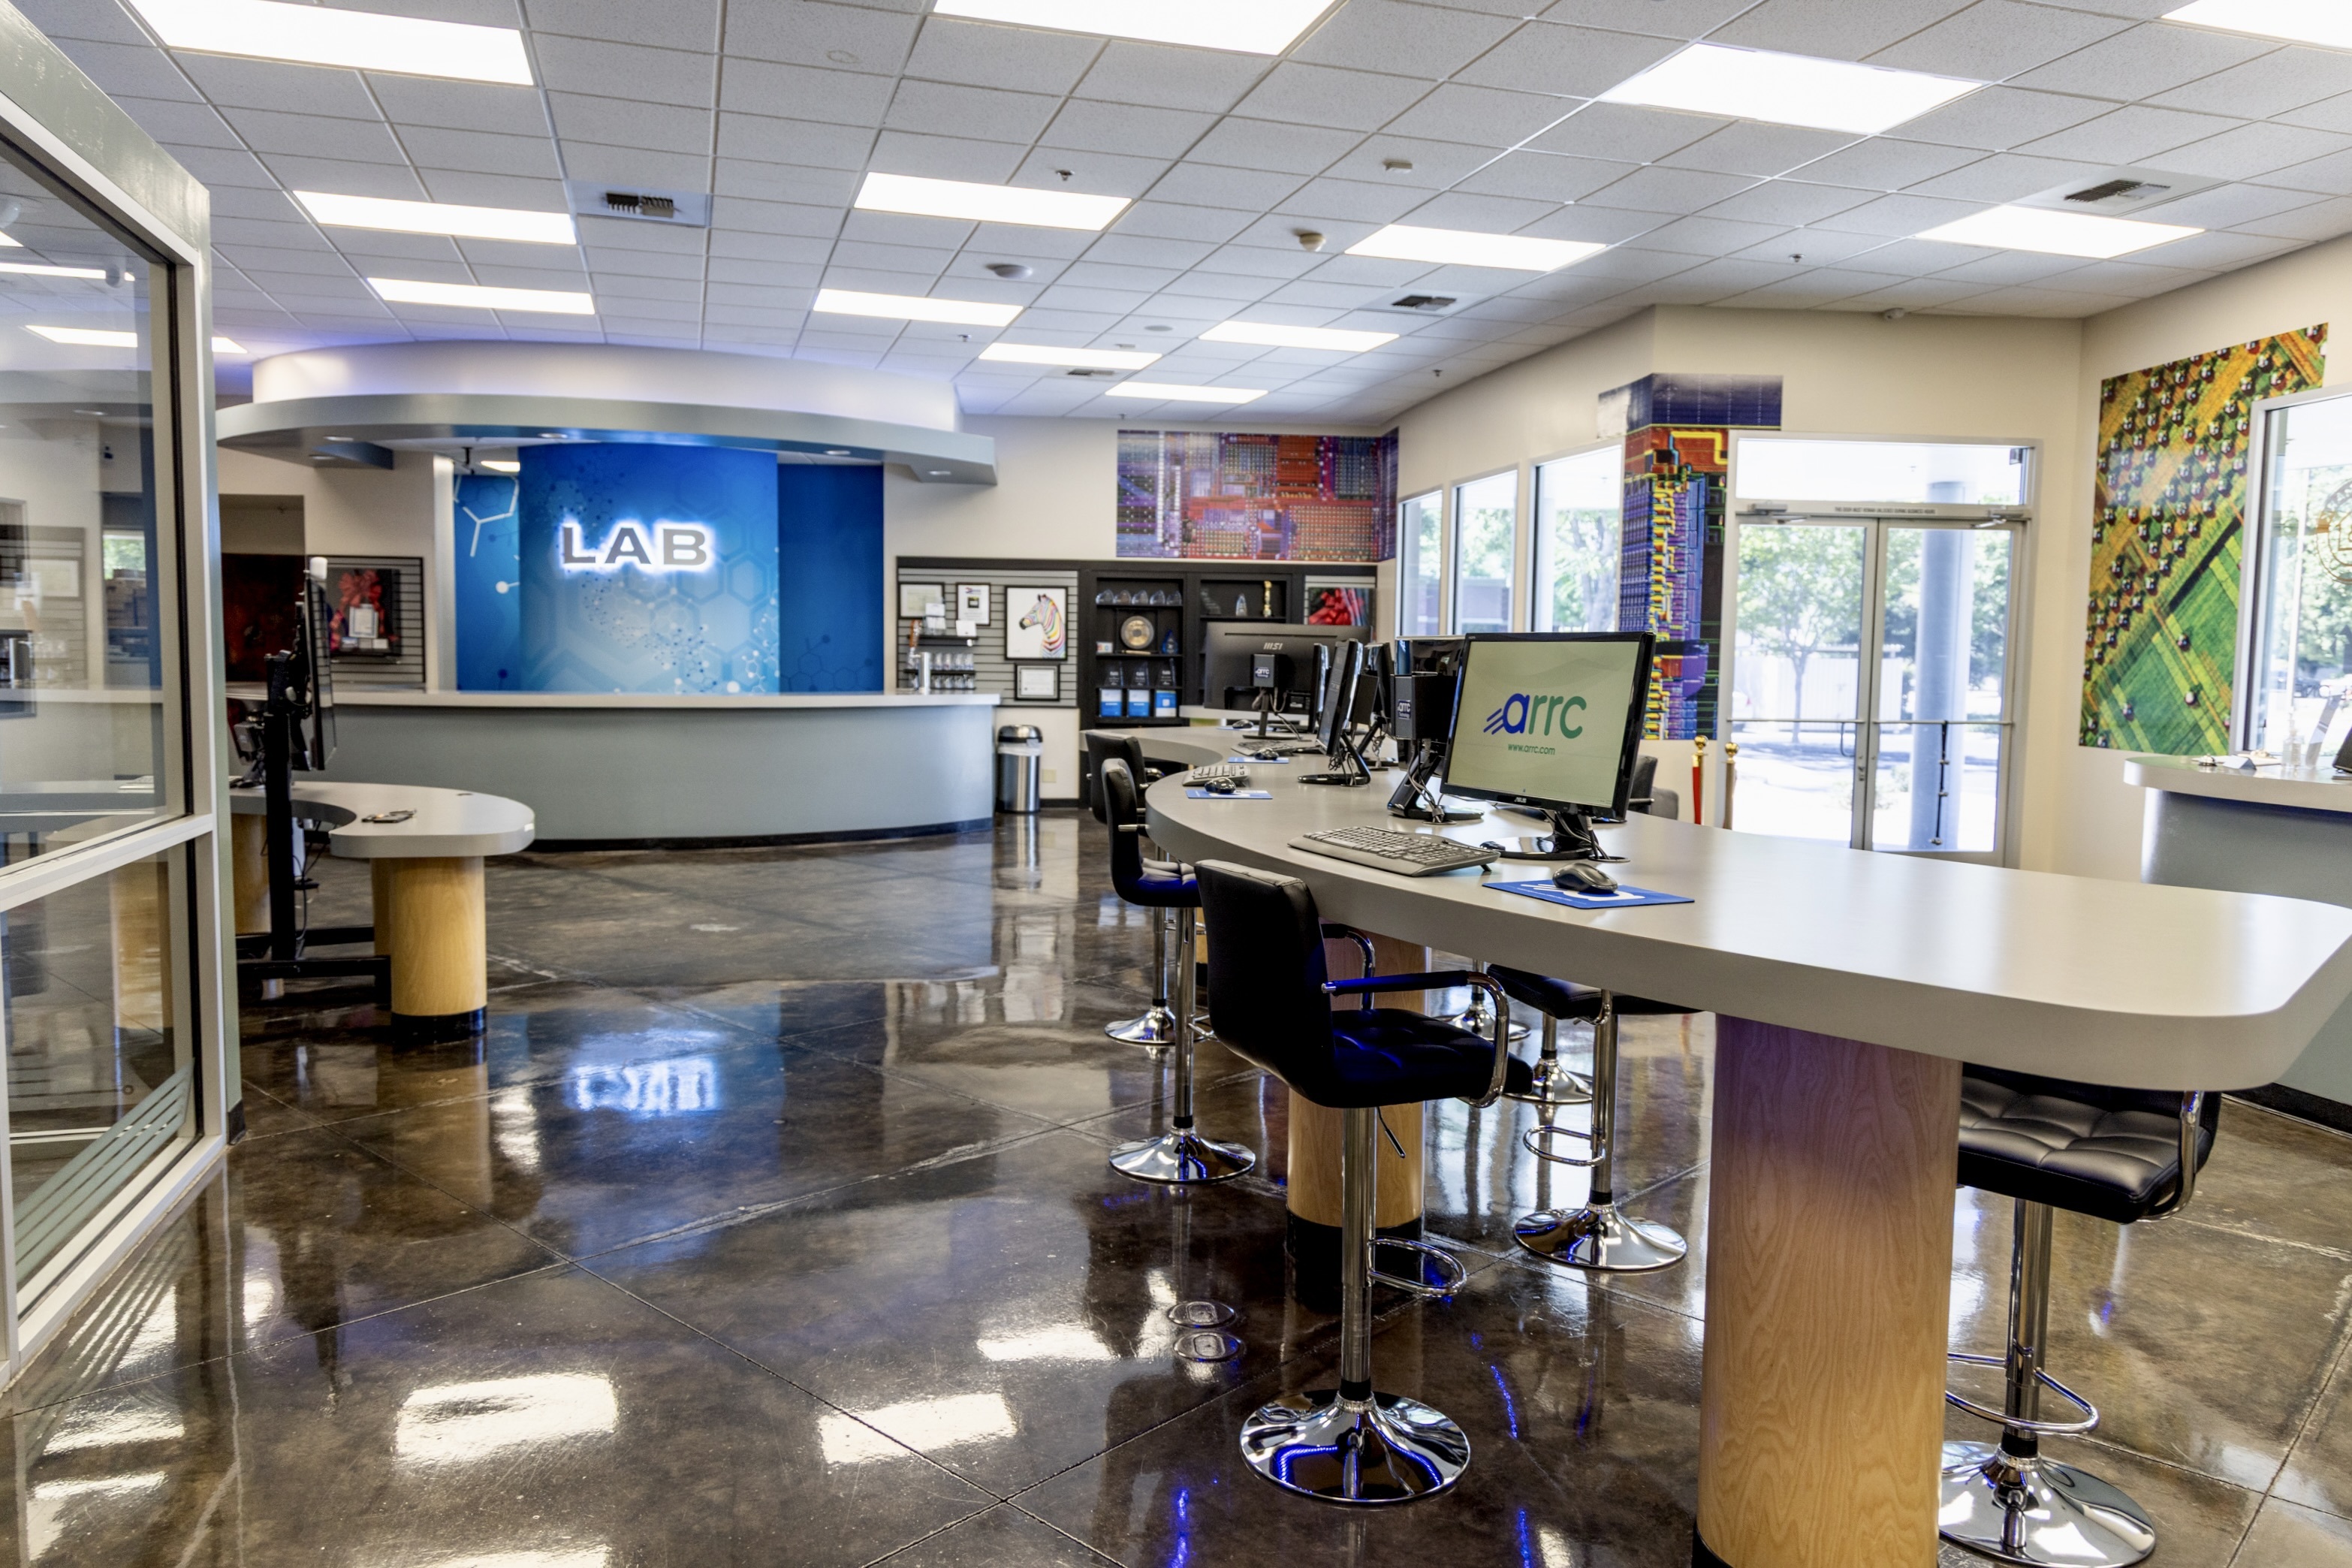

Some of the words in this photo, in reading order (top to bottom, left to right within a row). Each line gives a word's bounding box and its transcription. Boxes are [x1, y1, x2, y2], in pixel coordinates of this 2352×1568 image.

[563, 527, 707, 565] LAB
[1263, 642, 1283, 650] MSI
[1501, 693, 1587, 739] arrc
[1508, 743, 1556, 755] www.arrc.com
